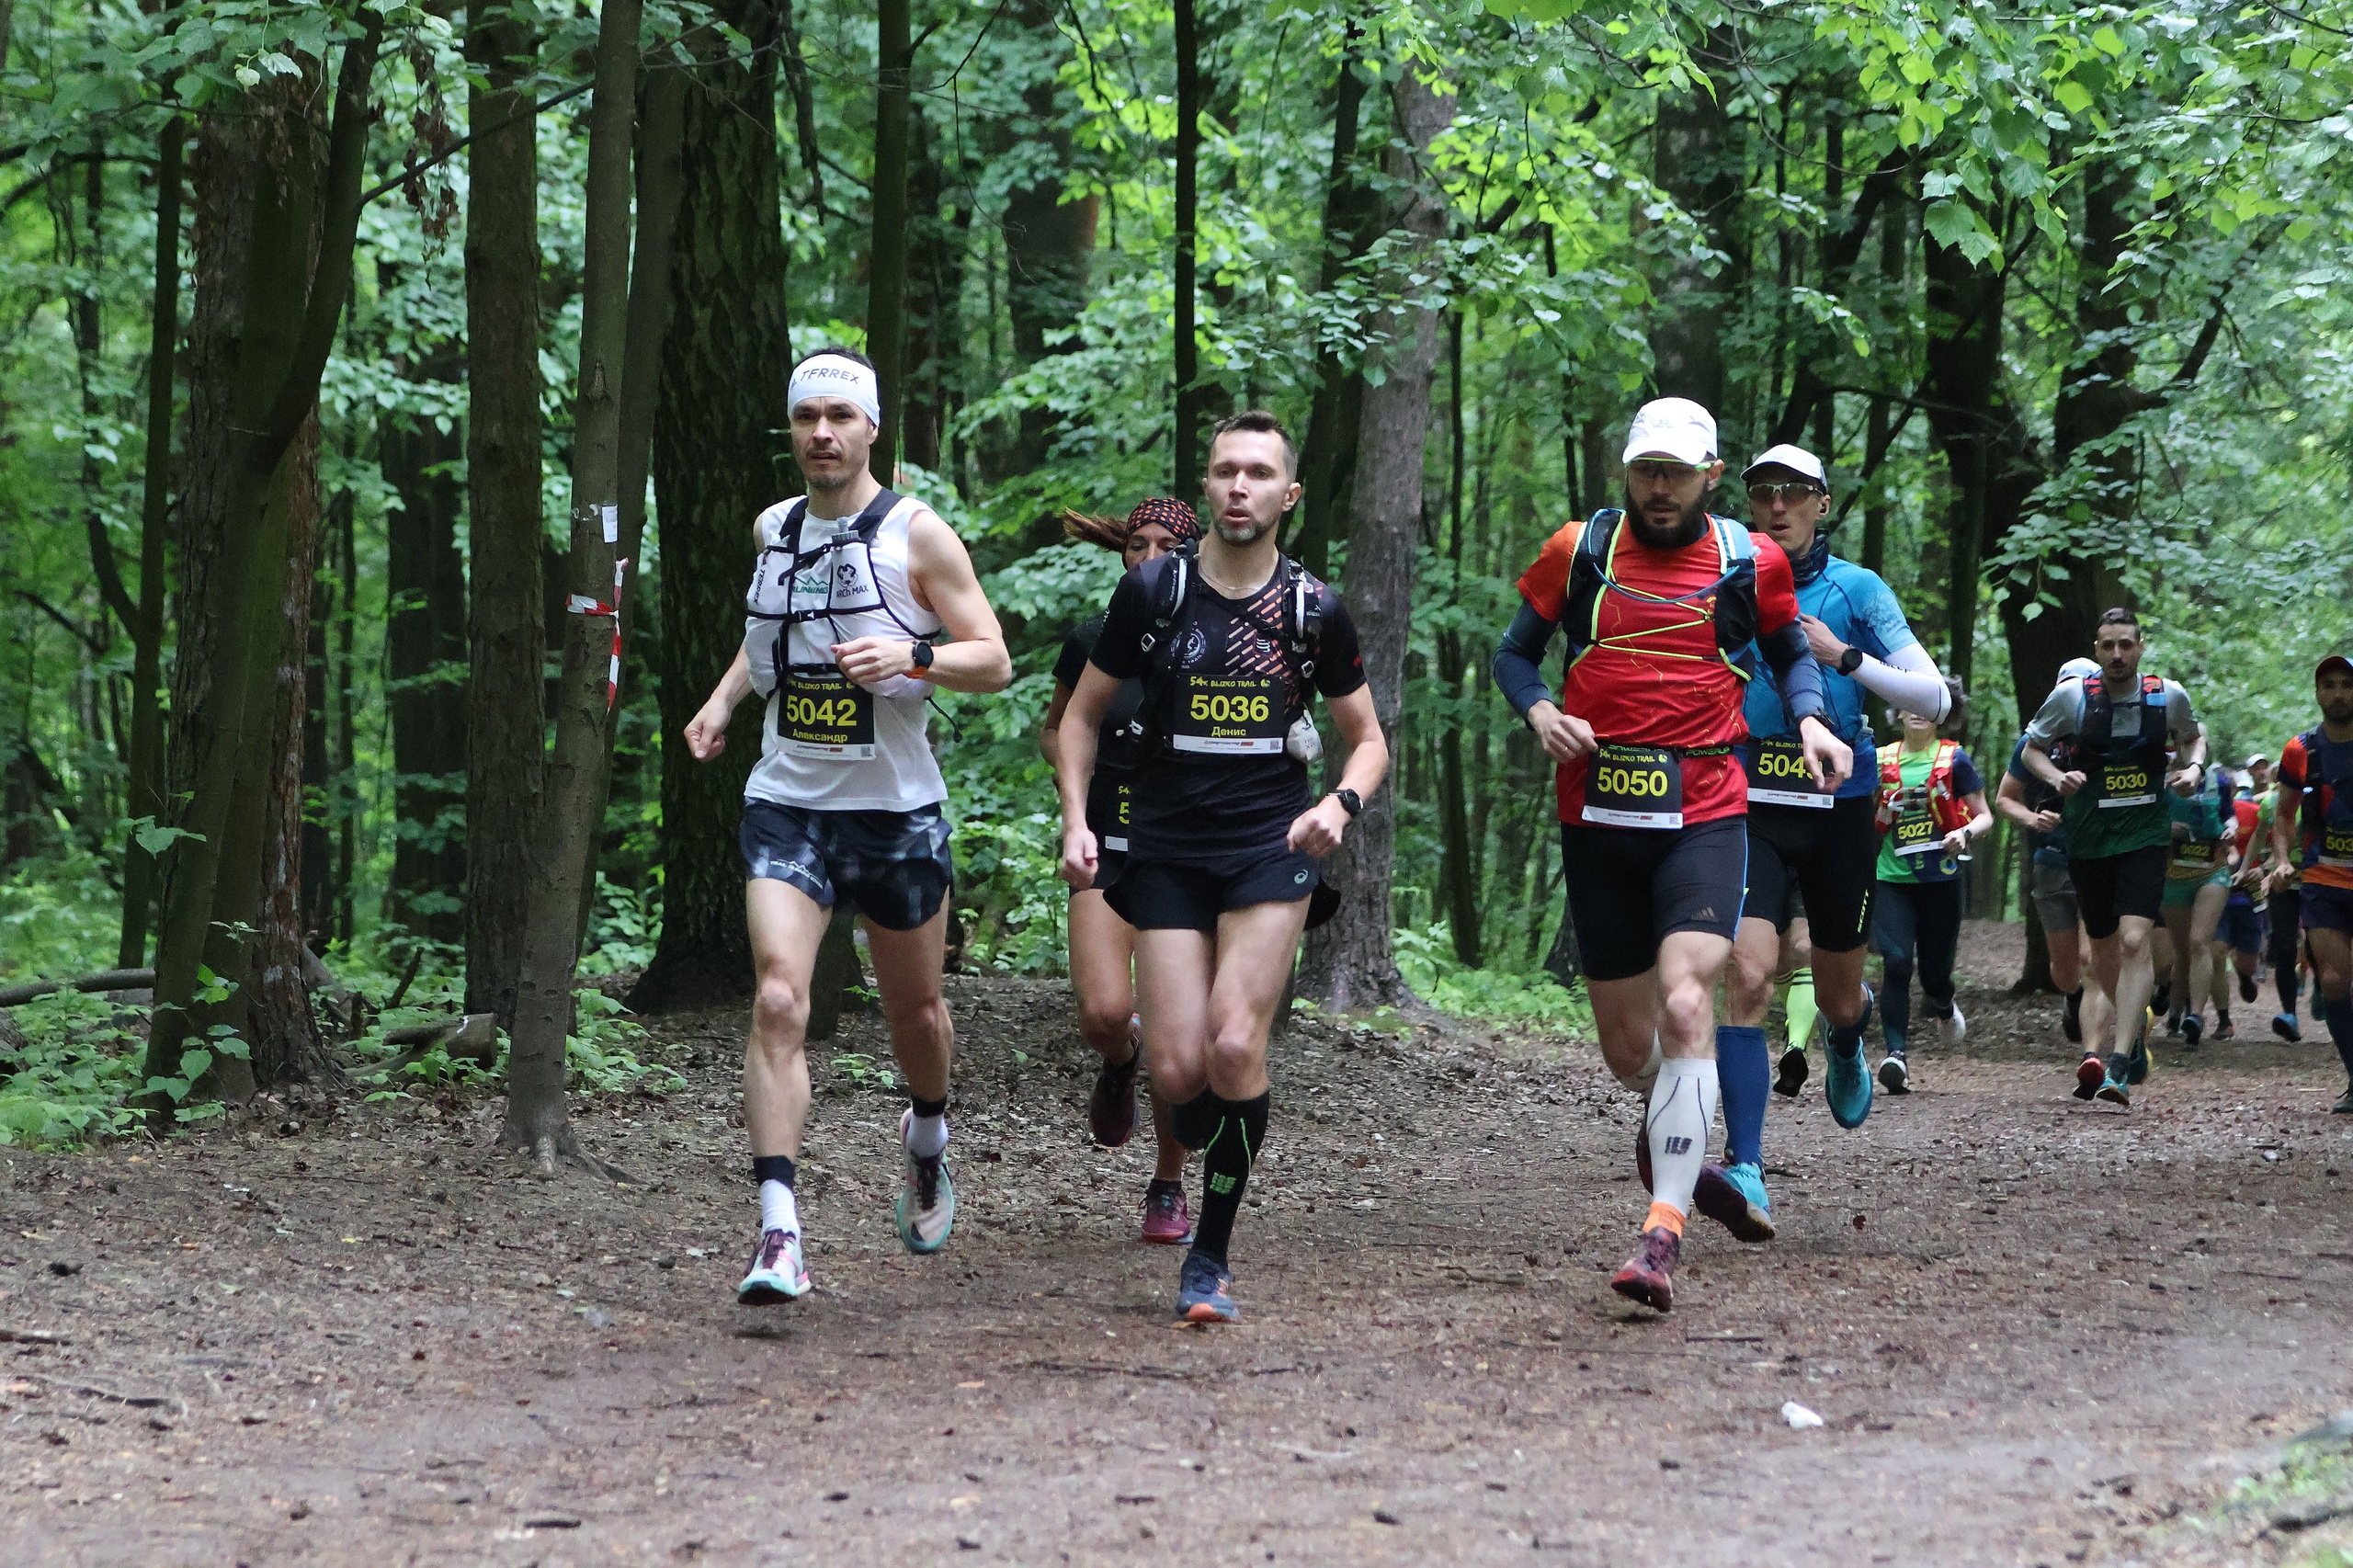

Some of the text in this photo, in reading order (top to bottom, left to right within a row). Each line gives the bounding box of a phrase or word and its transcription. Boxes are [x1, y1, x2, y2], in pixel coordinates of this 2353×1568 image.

[852, 584, 870, 596] MAX
[786, 694, 858, 726] 5042
[1189, 694, 1269, 722] 5036
[792, 728, 848, 744] Александр
[1211, 726, 1246, 738] Денис
[1636, 755, 1655, 763] TRAIL
[1597, 767, 1668, 797] 5050
[2105, 772, 2148, 790] 5030
[1897, 821, 1935, 840] 5027
